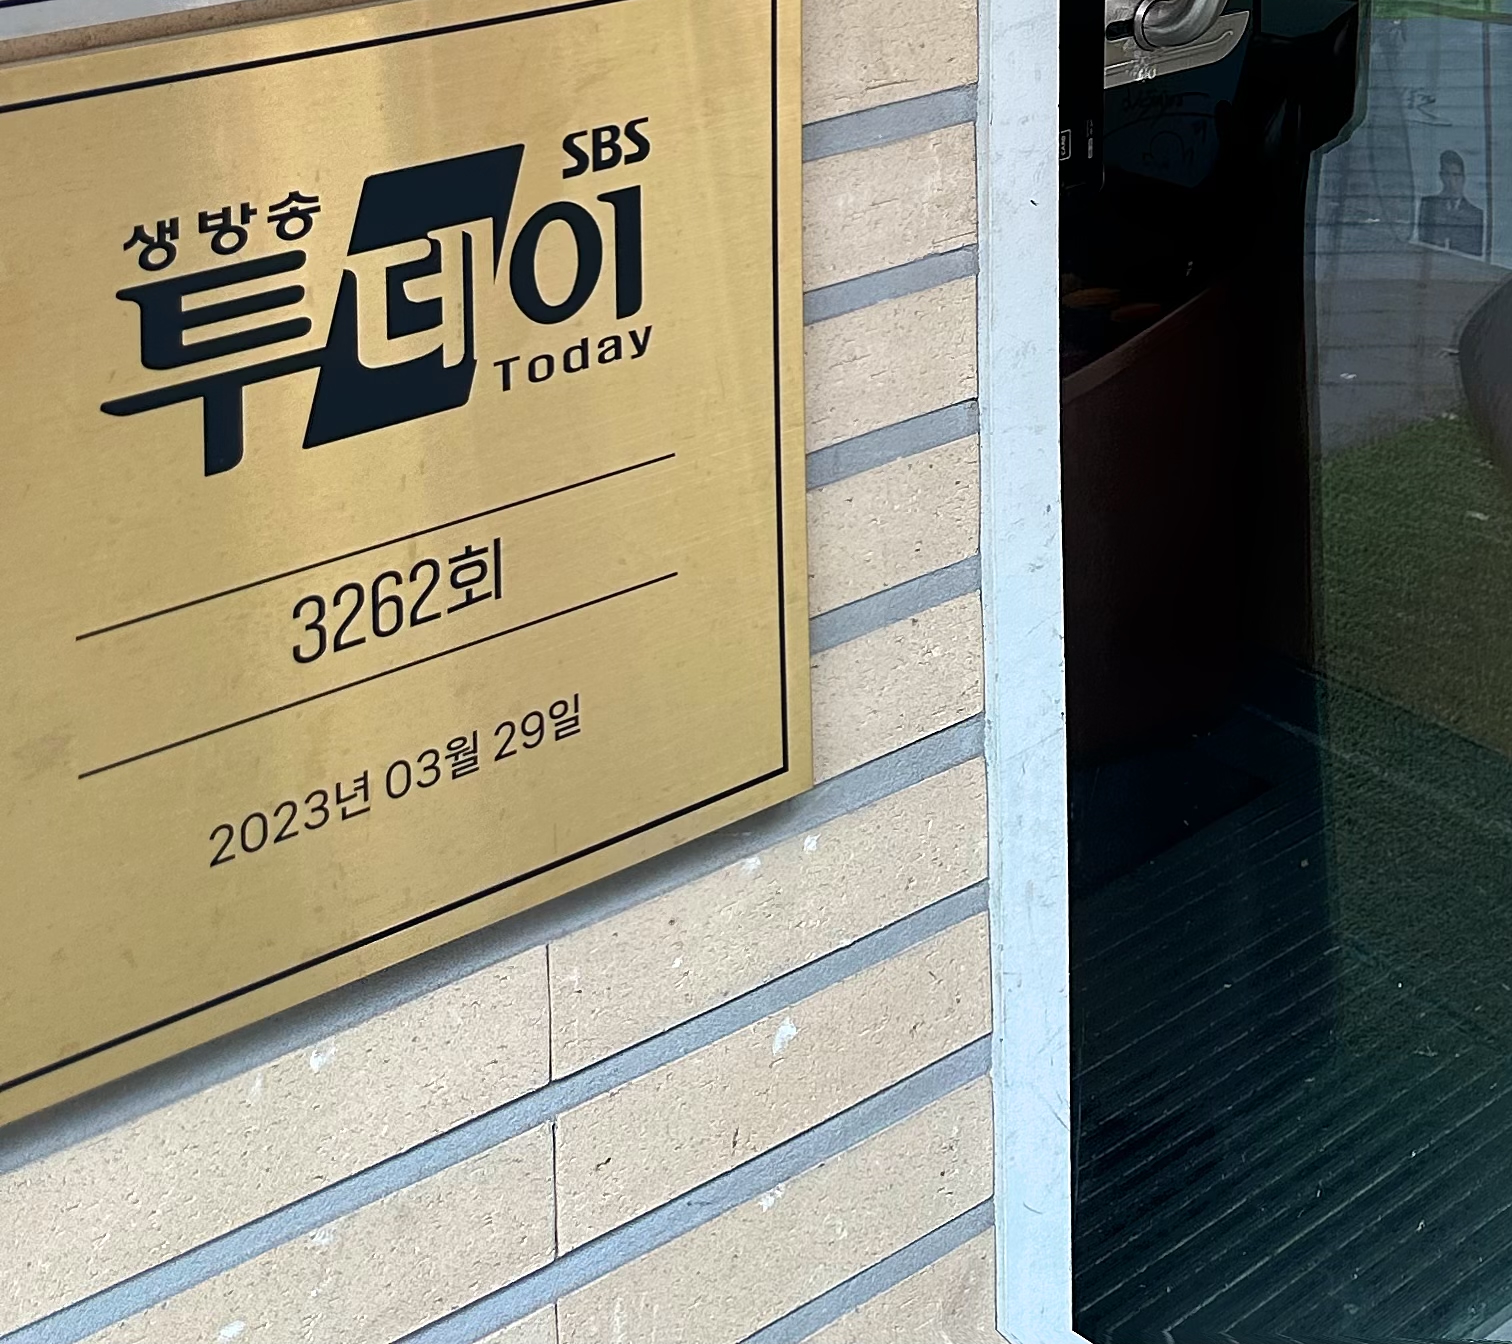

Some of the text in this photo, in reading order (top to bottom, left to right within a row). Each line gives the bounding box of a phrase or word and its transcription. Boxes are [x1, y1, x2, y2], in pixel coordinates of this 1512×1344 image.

[562, 117, 651, 179] SBS
[122, 191, 321, 272] 생방송
[100, 144, 643, 477] 투데이
[494, 326, 652, 393] Today
[292, 538, 502, 664] 3262회
[209, 693, 582, 867] 2023년 03월 29일
